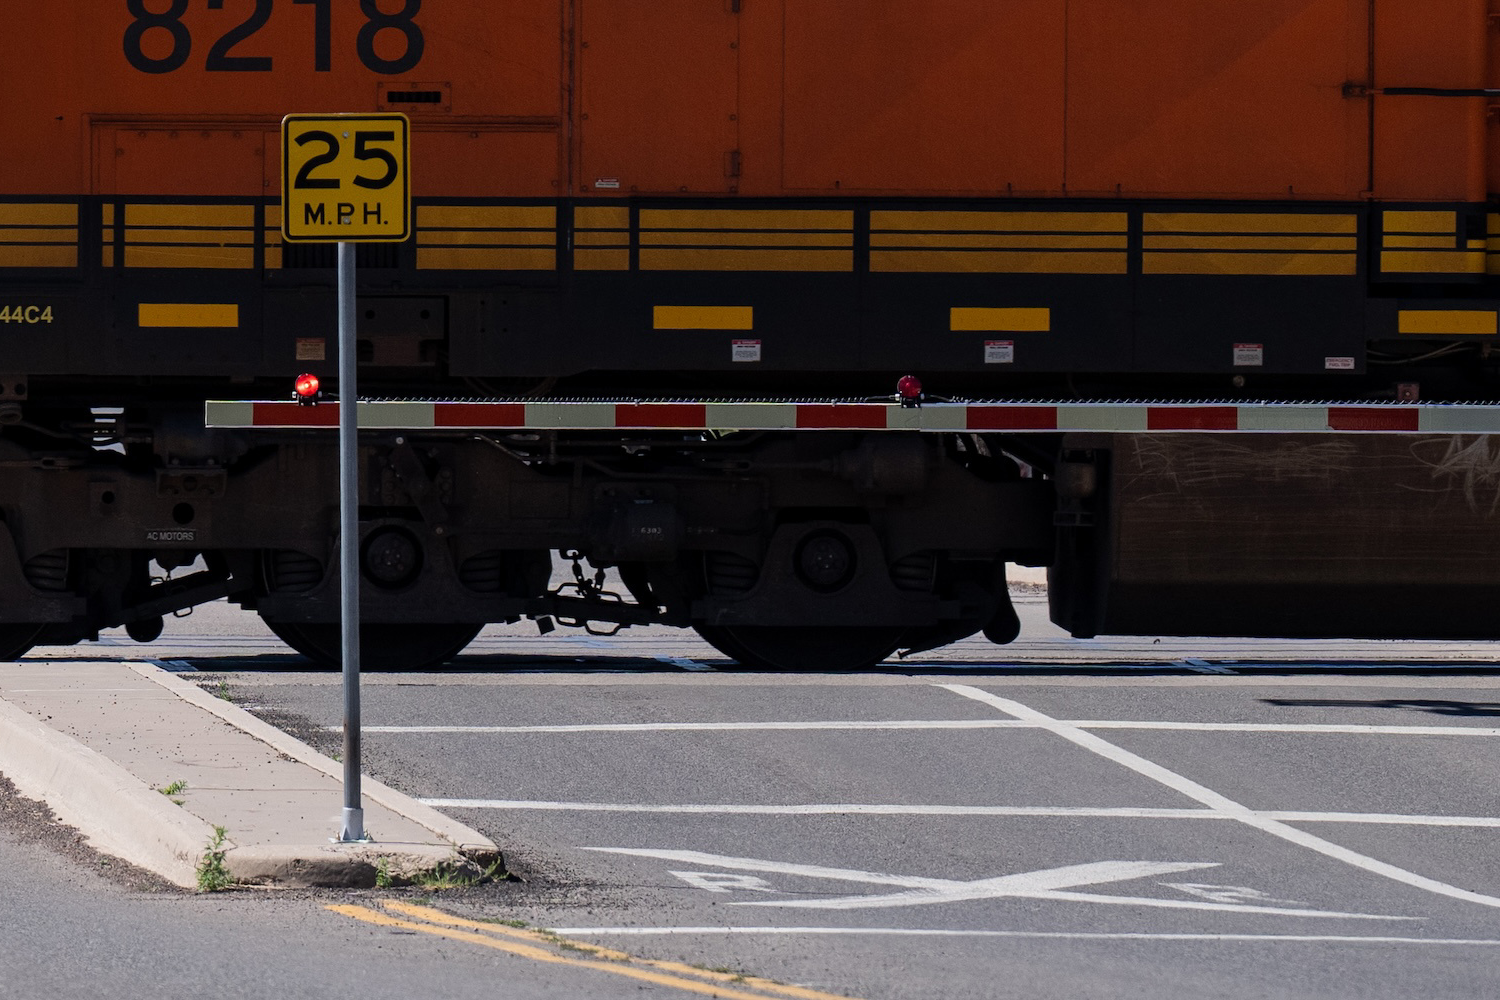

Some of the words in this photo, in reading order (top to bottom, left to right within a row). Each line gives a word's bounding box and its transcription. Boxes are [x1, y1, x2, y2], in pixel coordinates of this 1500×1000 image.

[294, 130, 398, 190] 25
[146, 532, 158, 540] AC
[159, 532, 194, 540] MOTORS
